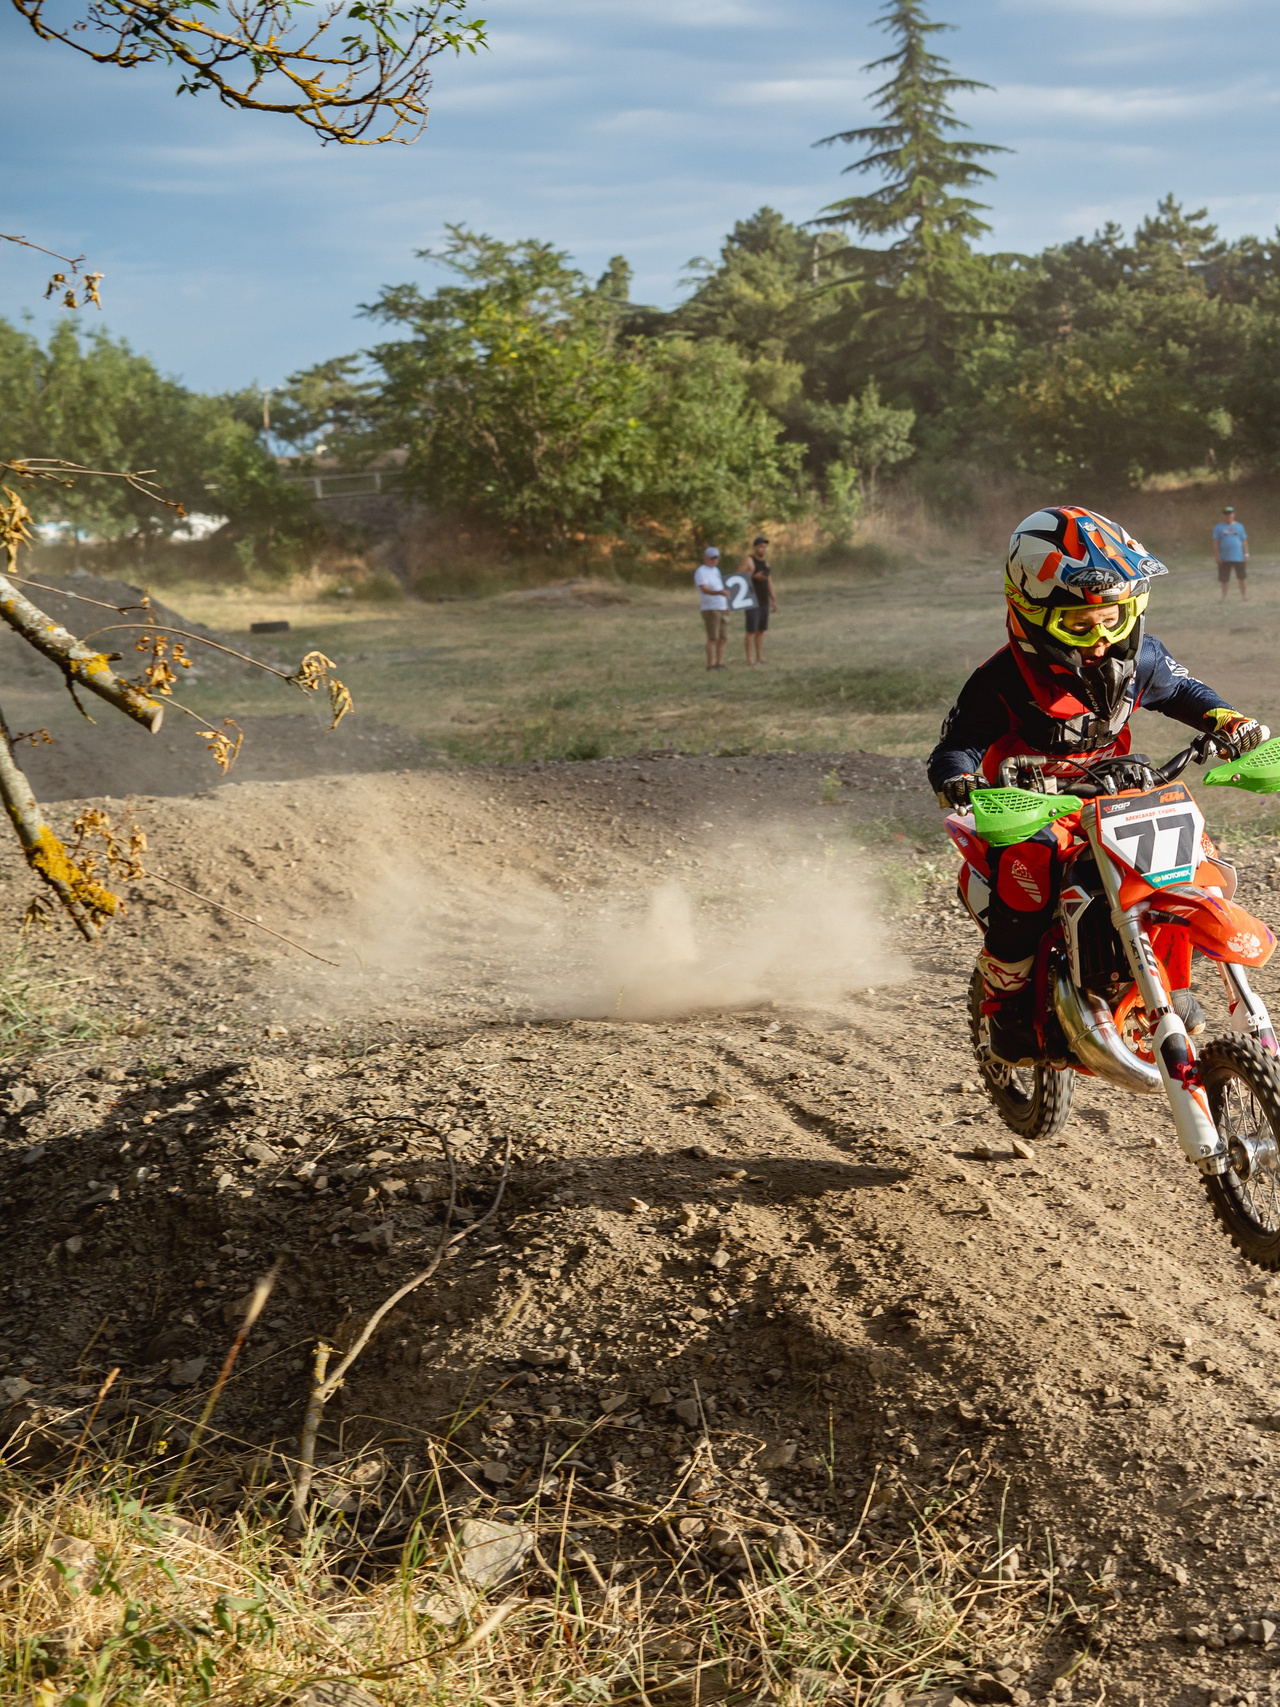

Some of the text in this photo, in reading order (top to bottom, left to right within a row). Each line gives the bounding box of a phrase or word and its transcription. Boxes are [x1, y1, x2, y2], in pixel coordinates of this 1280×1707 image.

[1070, 570, 1115, 583] Airoh
[725, 575, 754, 609] 2
[1085, 688, 1101, 713] AIROH
[1159, 791, 1186, 804] KTM
[1114, 813, 1195, 874] 77
[1161, 869, 1191, 882] MOTOREX
[1129, 938, 1141, 961] XACT
